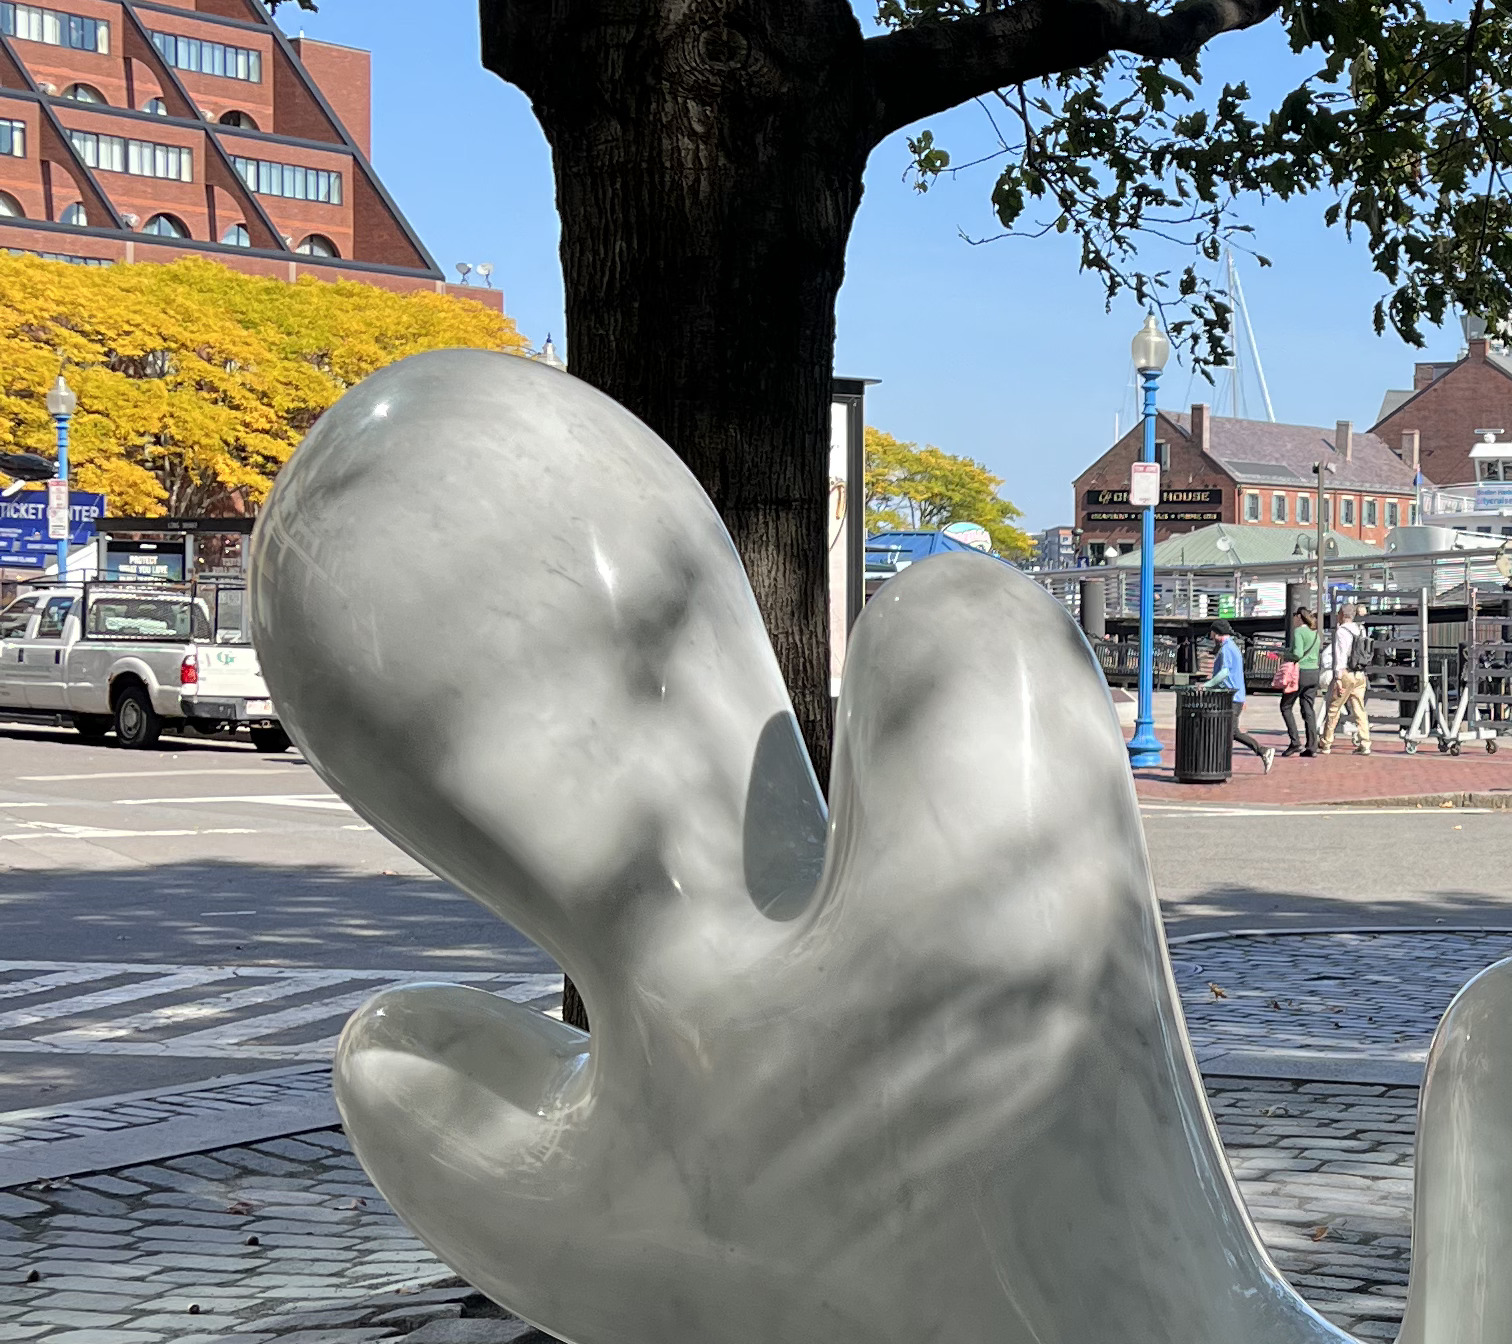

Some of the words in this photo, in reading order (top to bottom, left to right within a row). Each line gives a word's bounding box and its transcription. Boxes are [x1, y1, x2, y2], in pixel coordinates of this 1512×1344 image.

[1163, 492, 1210, 502] HOUSE
[0, 502, 45, 520] TICKET
[46, 505, 100, 522] NTER
